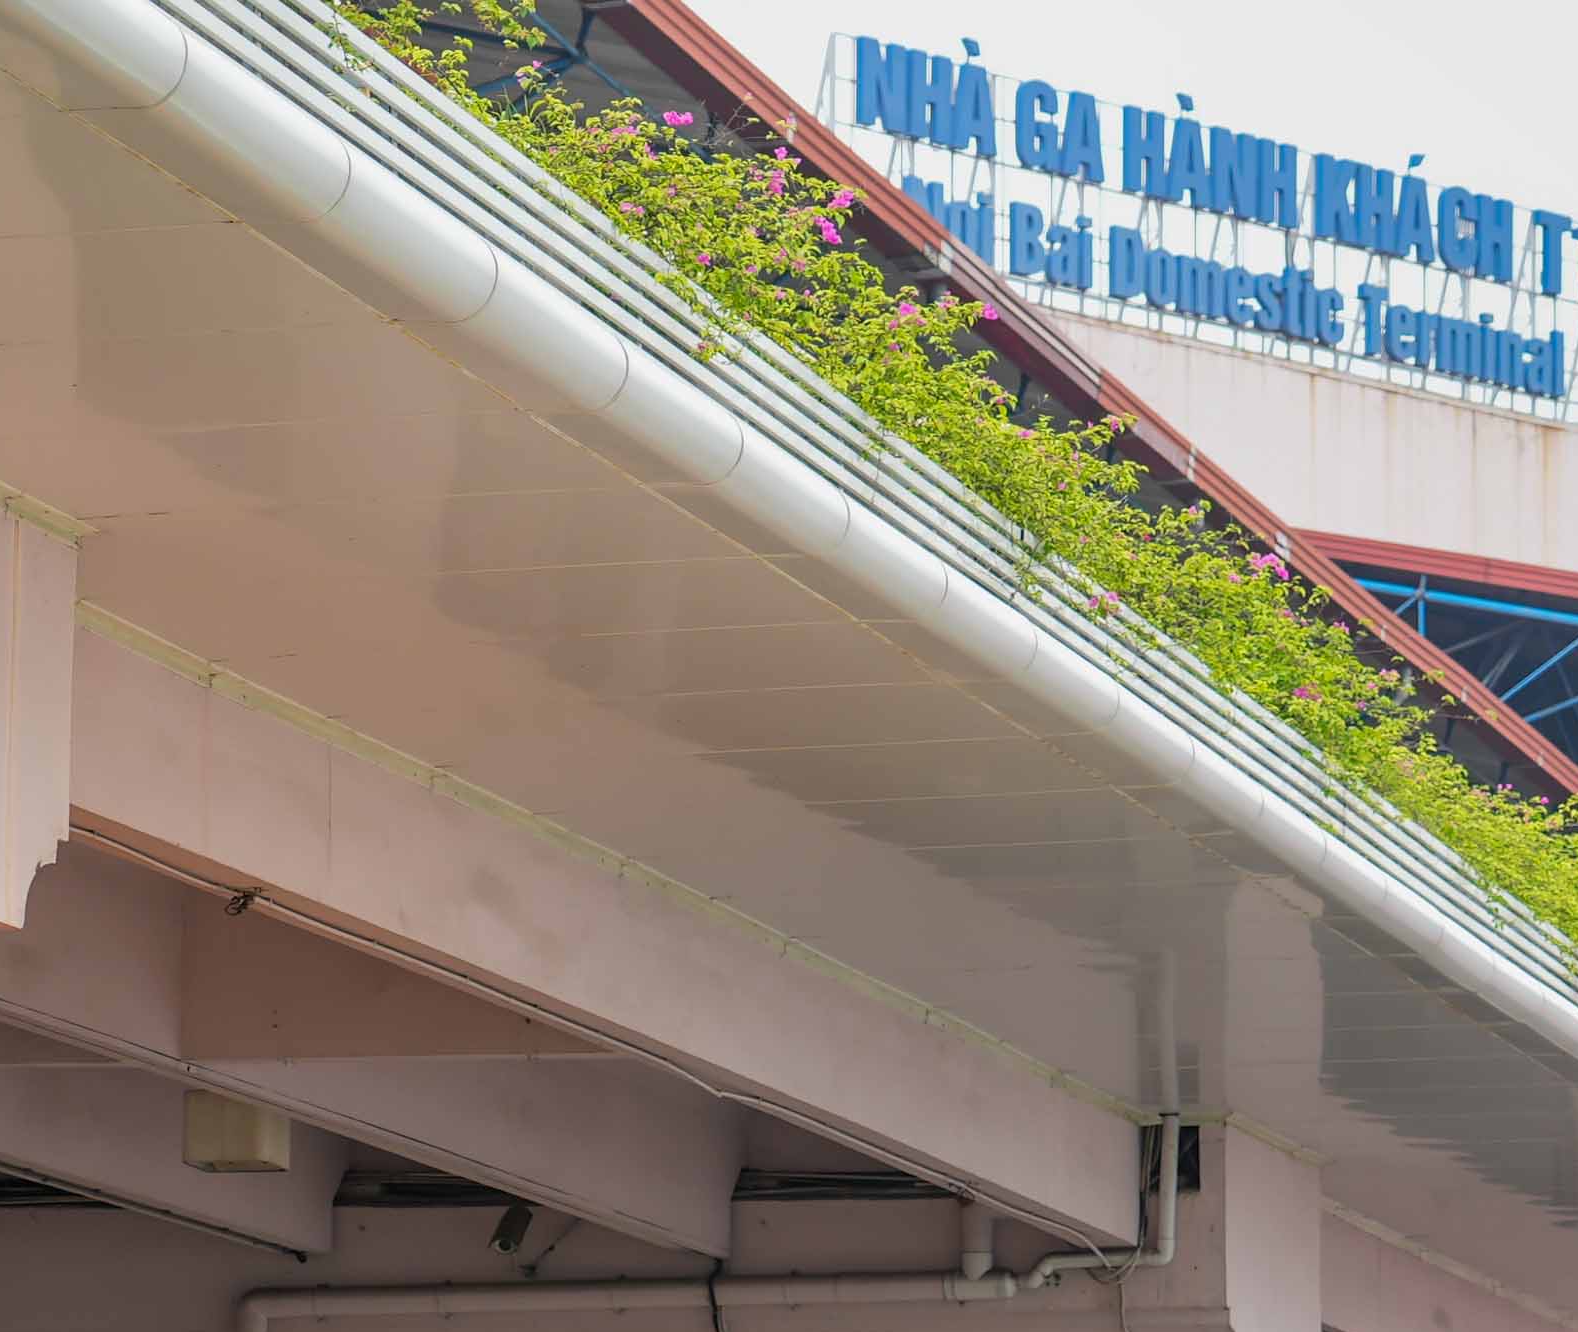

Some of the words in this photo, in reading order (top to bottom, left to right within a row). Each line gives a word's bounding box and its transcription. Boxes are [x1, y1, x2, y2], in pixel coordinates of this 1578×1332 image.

[856, 36, 997, 158] NHÀ
[1015, 80, 1105, 184] GA
[1122, 92, 1298, 229] HÀNH
[1315, 153, 1514, 283] KHÁCH
[1009, 202, 1094, 290] Bai
[1109, 225, 1344, 346] Domestic
[1357, 282, 1566, 399] Terminal
